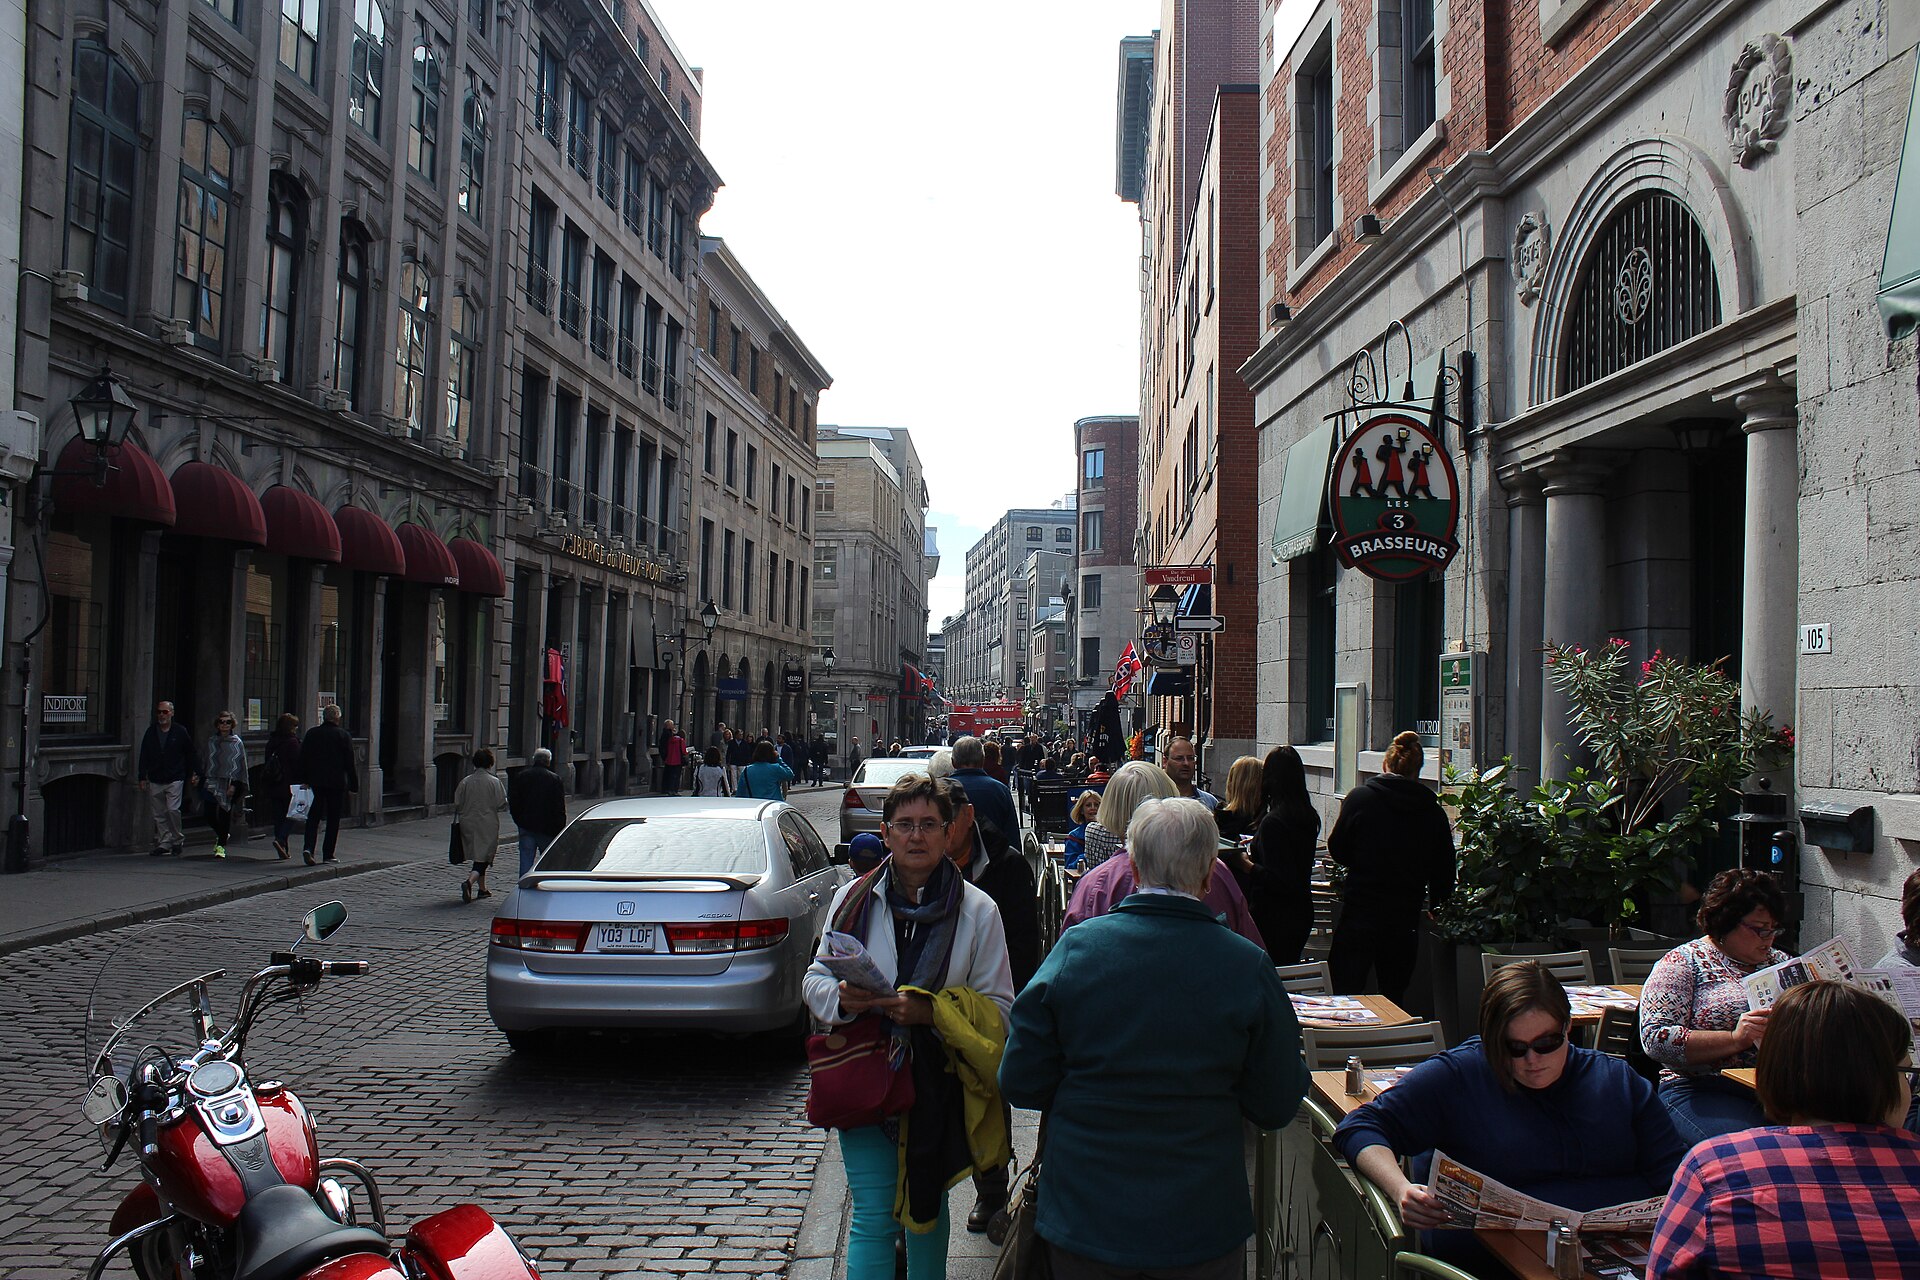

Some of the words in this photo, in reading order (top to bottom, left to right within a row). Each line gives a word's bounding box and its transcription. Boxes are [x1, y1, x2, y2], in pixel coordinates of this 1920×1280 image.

[1393, 515, 1405, 528] 3
[1350, 536, 1448, 560] BRASSEURS
[1162, 574, 1196, 582] Vaudreuil
[1807, 628, 1823, 649] 105
[44, 698, 87, 710] INDIPORT
[601, 928, 623, 943] Y03
